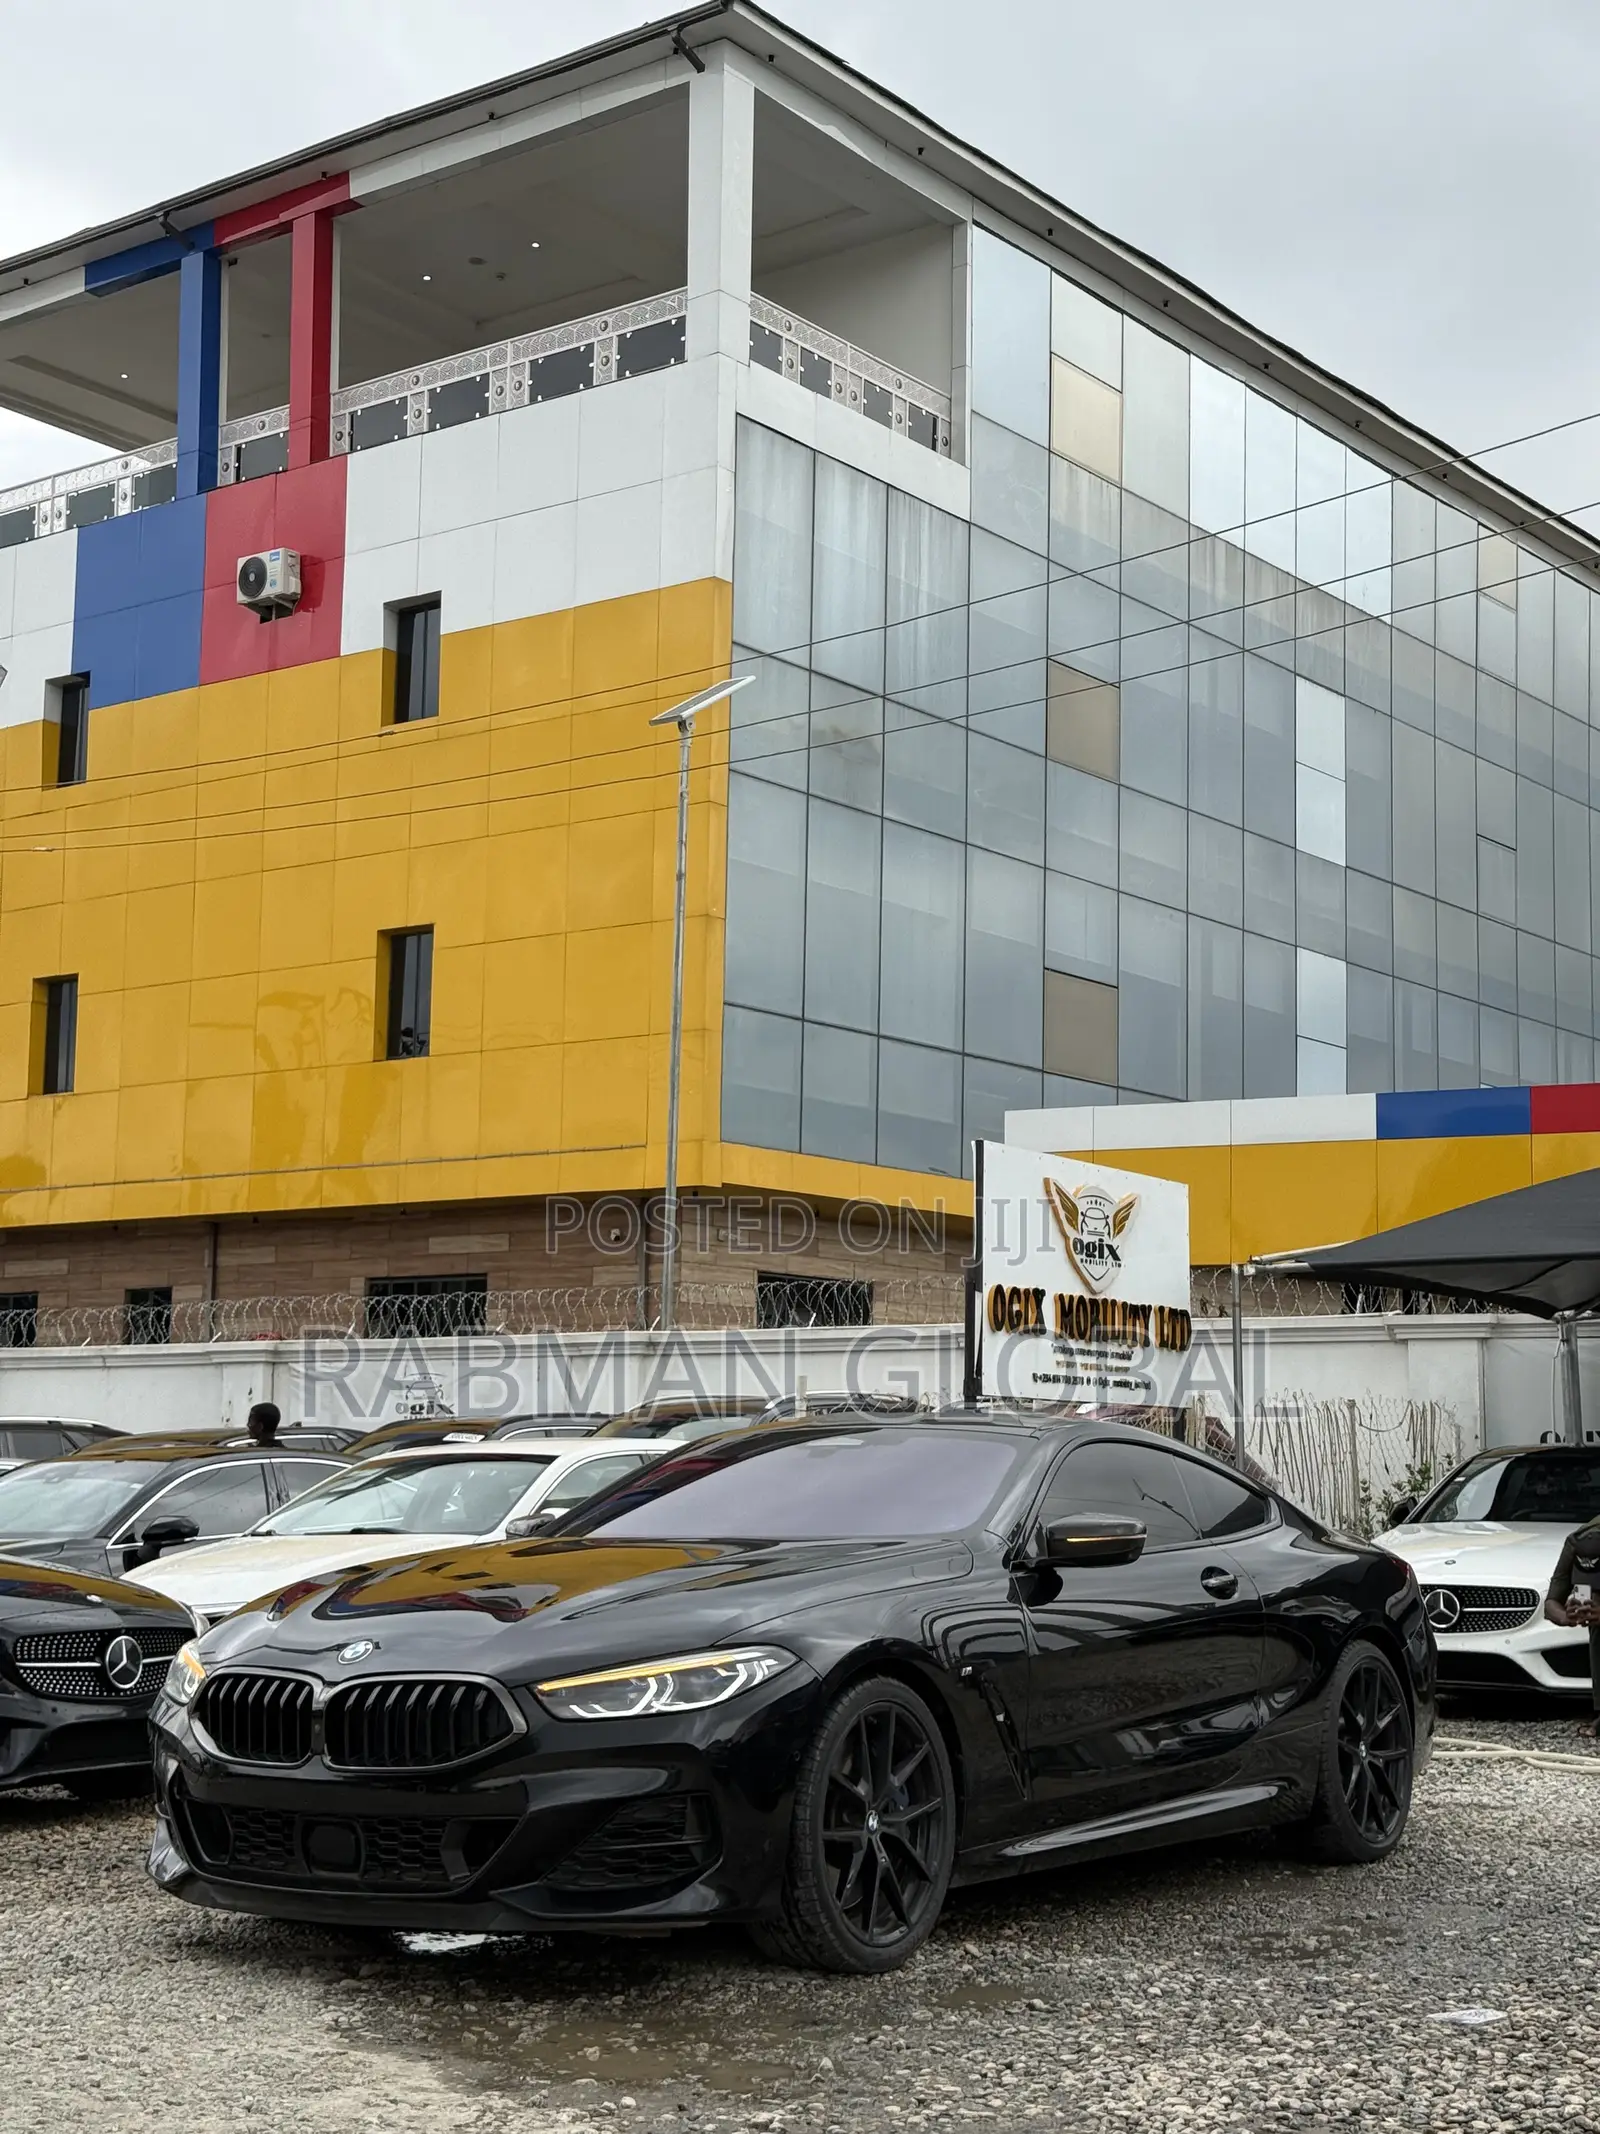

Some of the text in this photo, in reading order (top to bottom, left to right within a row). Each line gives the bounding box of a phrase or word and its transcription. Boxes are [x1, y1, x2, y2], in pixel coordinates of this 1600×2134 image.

[988, 1284, 1192, 1352] OGIX MOBILITY LTD
